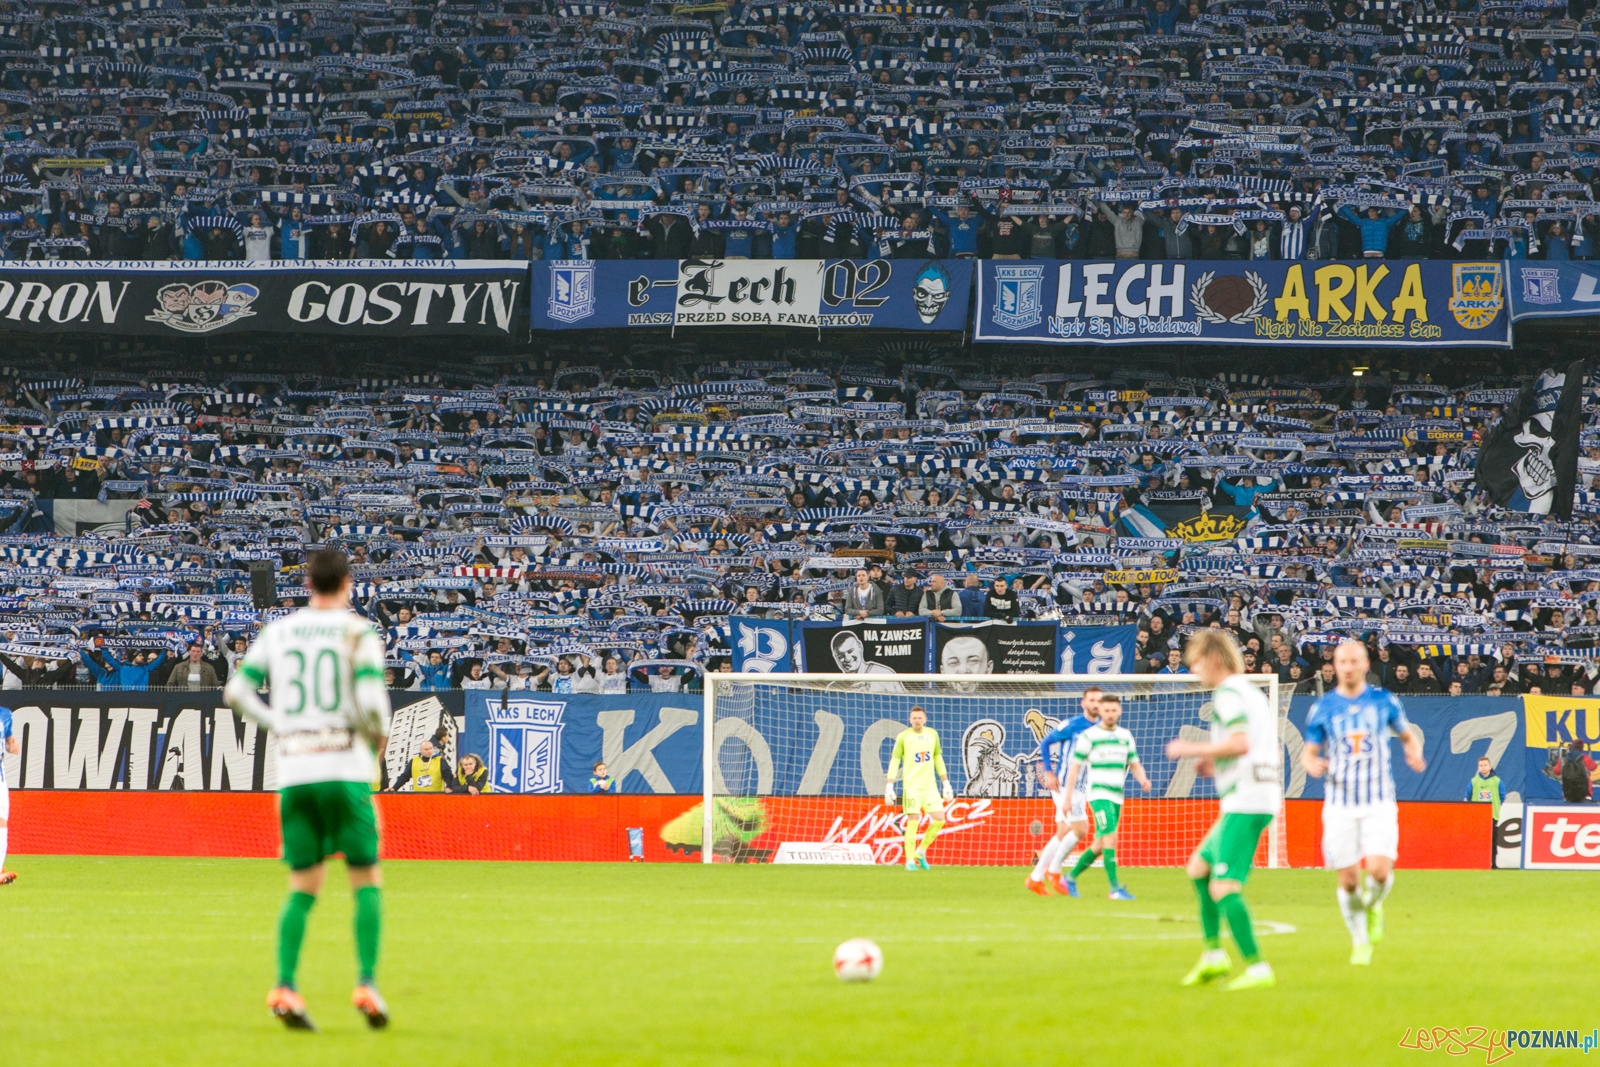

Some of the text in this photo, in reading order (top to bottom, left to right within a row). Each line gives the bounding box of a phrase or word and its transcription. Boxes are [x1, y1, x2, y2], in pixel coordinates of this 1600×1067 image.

[119, 261, 155, 269] DOM
[170, 261, 256, 270] KOLEJORZ
[1055, 263, 1185, 318] LECH
[1274, 263, 1429, 324] ARKA
[287, 279, 520, 333] GOSTYŃ
[629, 314, 672, 324] MASZ
[677, 312, 727, 323] PRZED
[778, 312, 873, 326] FANATYKÓW
[1049, 315, 1202, 337] Nigdy Się Nie Poddawaj
[1255, 317, 1442, 339] Nigdy Nie Zostaniesz Sam
[1062, 490, 1120, 500] KOLEJORZ
[1121, 539, 1181, 547] SZAMOTUŁY
[1138, 573, 1152, 581] ON
[864, 629, 922, 641] NA ZAWSZE
[104, 638, 167, 646] KOLSCY FANATYCY
[875, 645, 911, 656] Z NAMI
[285, 648, 341, 715] 30
[496, 706, 556, 722] KKS LECH
[1341, 731, 1376, 756] STS
[914, 751, 931, 763] STS
[1479, 791, 1491, 800] STS
